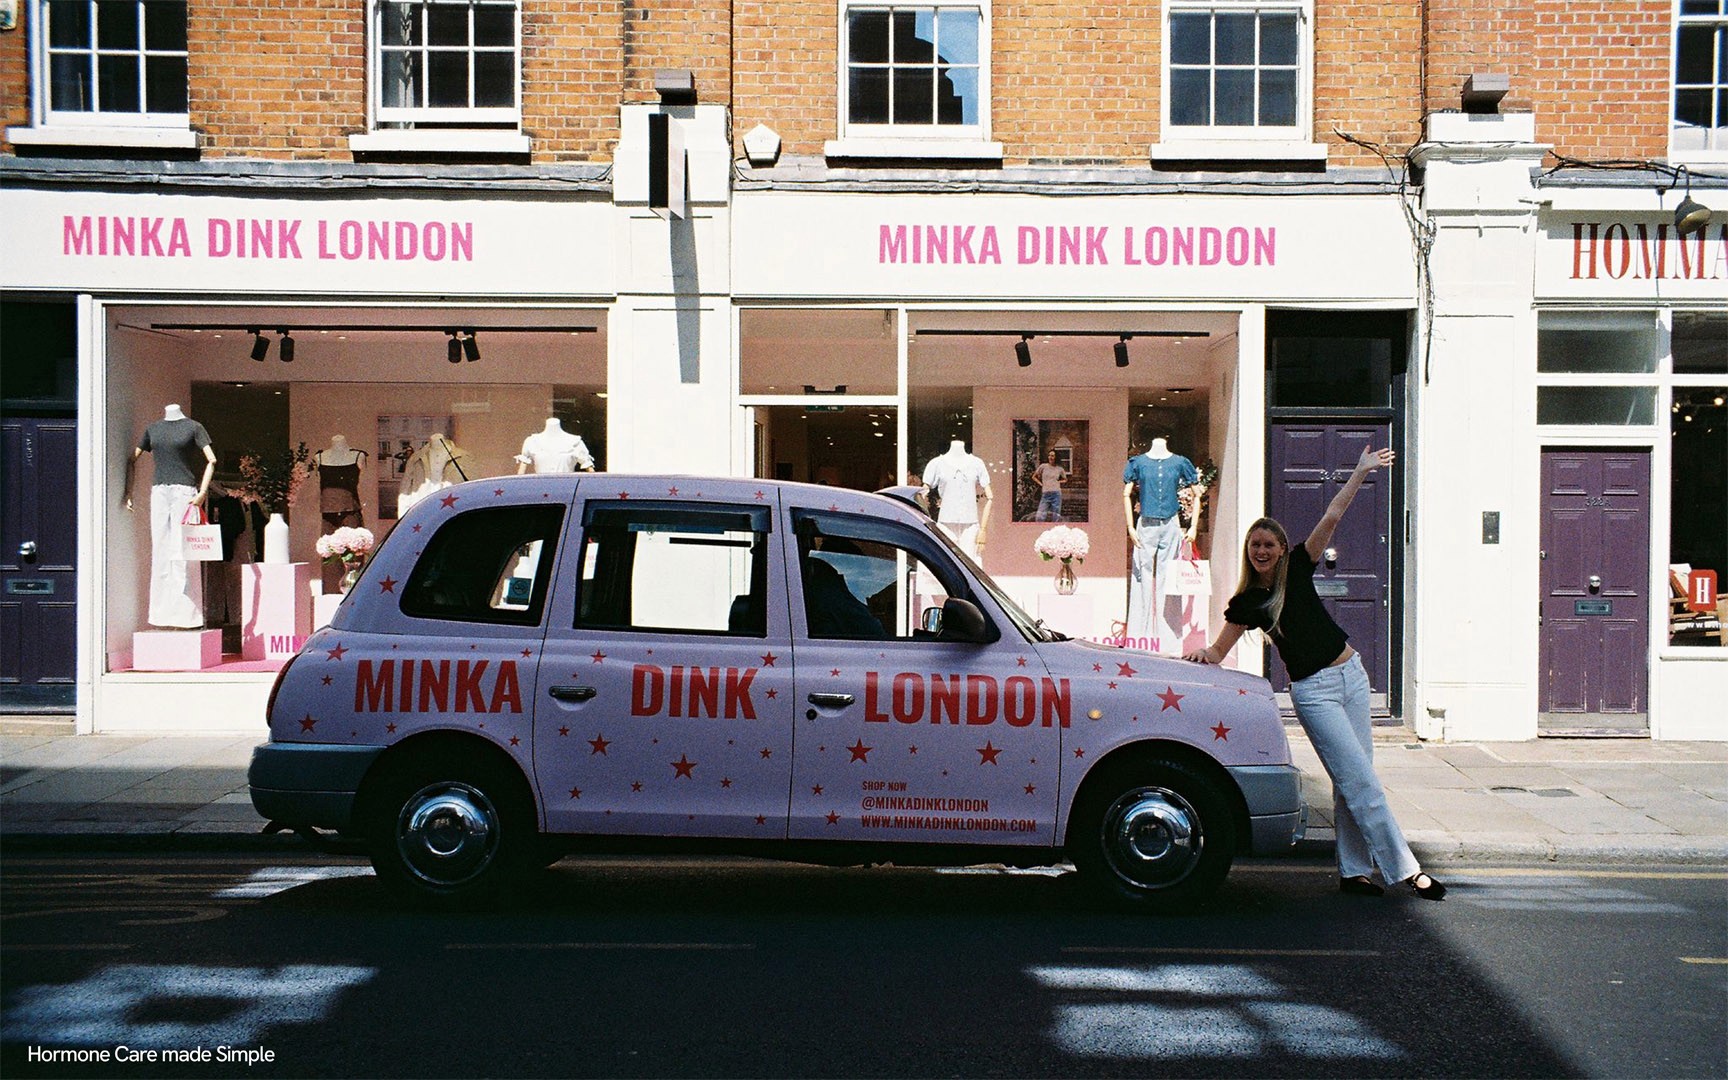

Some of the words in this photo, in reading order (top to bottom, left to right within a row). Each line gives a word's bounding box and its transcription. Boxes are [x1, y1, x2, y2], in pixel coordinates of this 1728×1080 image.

[63, 215, 192, 257] MINKA
[207, 217, 303, 259] DINK
[318, 219, 473, 261] LONDON
[879, 224, 1002, 264] MINKA
[1017, 225, 1109, 265] DINK
[1123, 226, 1276, 266] LONDON
[1694, 577, 1711, 604] H
[354, 659, 523, 713] MINKA
[631, 664, 759, 720] DINK
[864, 671, 1071, 728] LONDON
[862, 781, 885, 791] SHOP
[888, 781, 907, 791] NOW
[862, 796, 989, 812] @MINKADINKLONDON
[861, 815, 1037, 832] WWW.MINKADINKLONDON.COM
